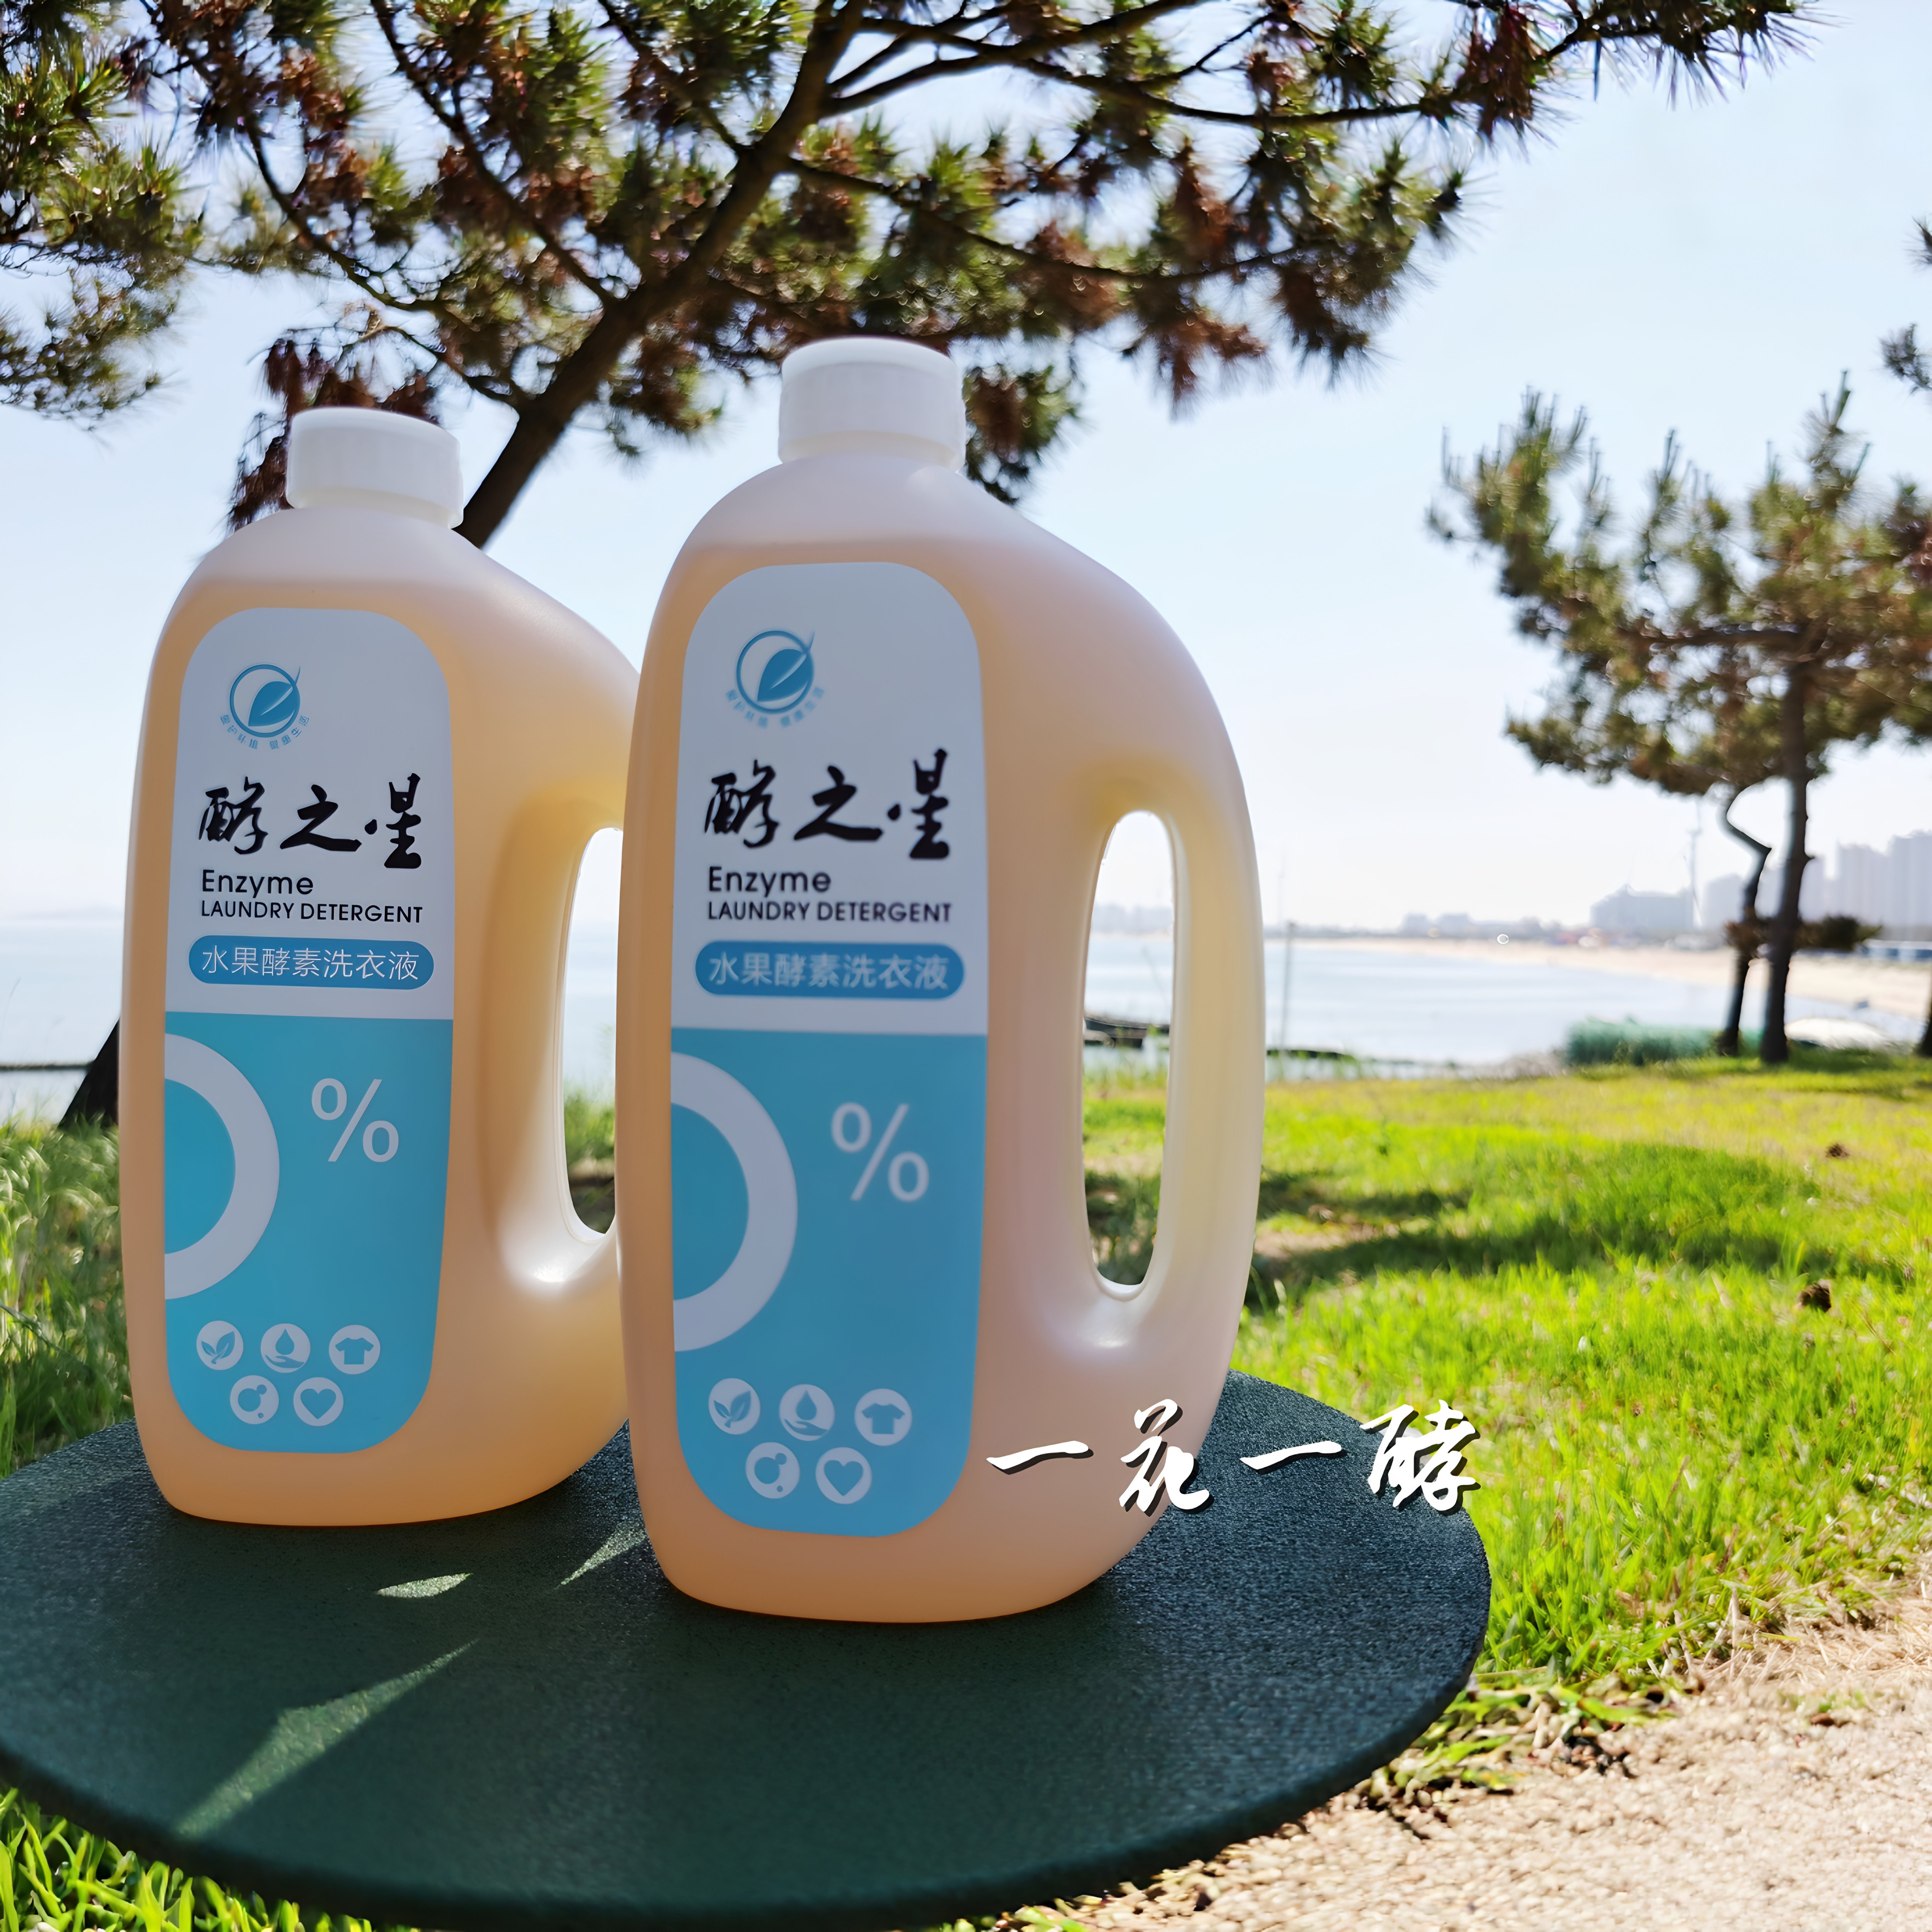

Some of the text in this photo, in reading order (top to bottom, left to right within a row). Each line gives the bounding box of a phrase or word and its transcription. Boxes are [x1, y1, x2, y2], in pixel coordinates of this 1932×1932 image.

[202, 869, 314, 899] Enzyme
[708, 866, 831, 898] Enzyme
[201, 900, 423, 923] LAUNDRY DETERGENT
[708, 901, 952, 922] LAUNDRY DETERGENT
[202, 945, 420, 980] 水果酵素洗衣液
[709, 951, 949, 990] 水果酵素洗衣液
